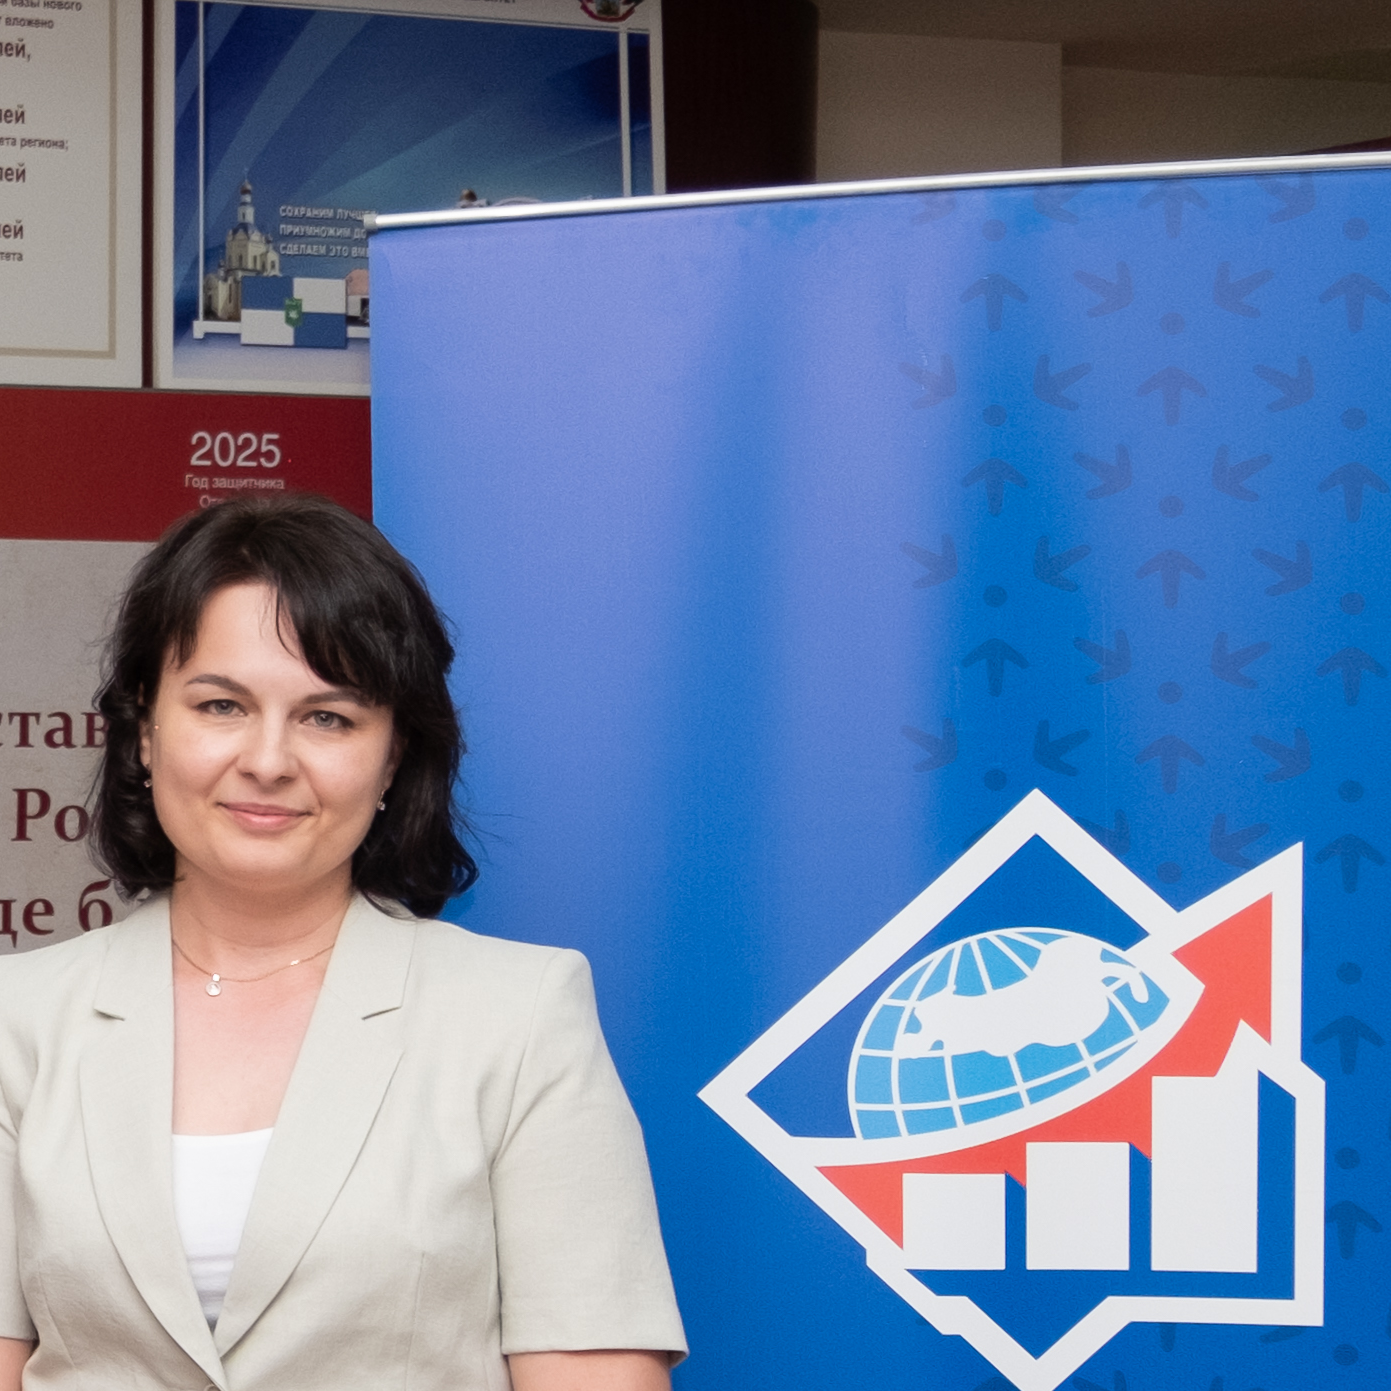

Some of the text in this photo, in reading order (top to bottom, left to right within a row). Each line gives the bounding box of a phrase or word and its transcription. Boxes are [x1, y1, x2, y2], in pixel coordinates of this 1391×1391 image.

[5, 16, 54, 29] вложено
[279, 243, 326, 256] СДЕЛАЕМ
[329, 245, 350, 257] ЭТО
[190, 431, 281, 468] 2025
[184, 474, 285, 491] Год защитника
